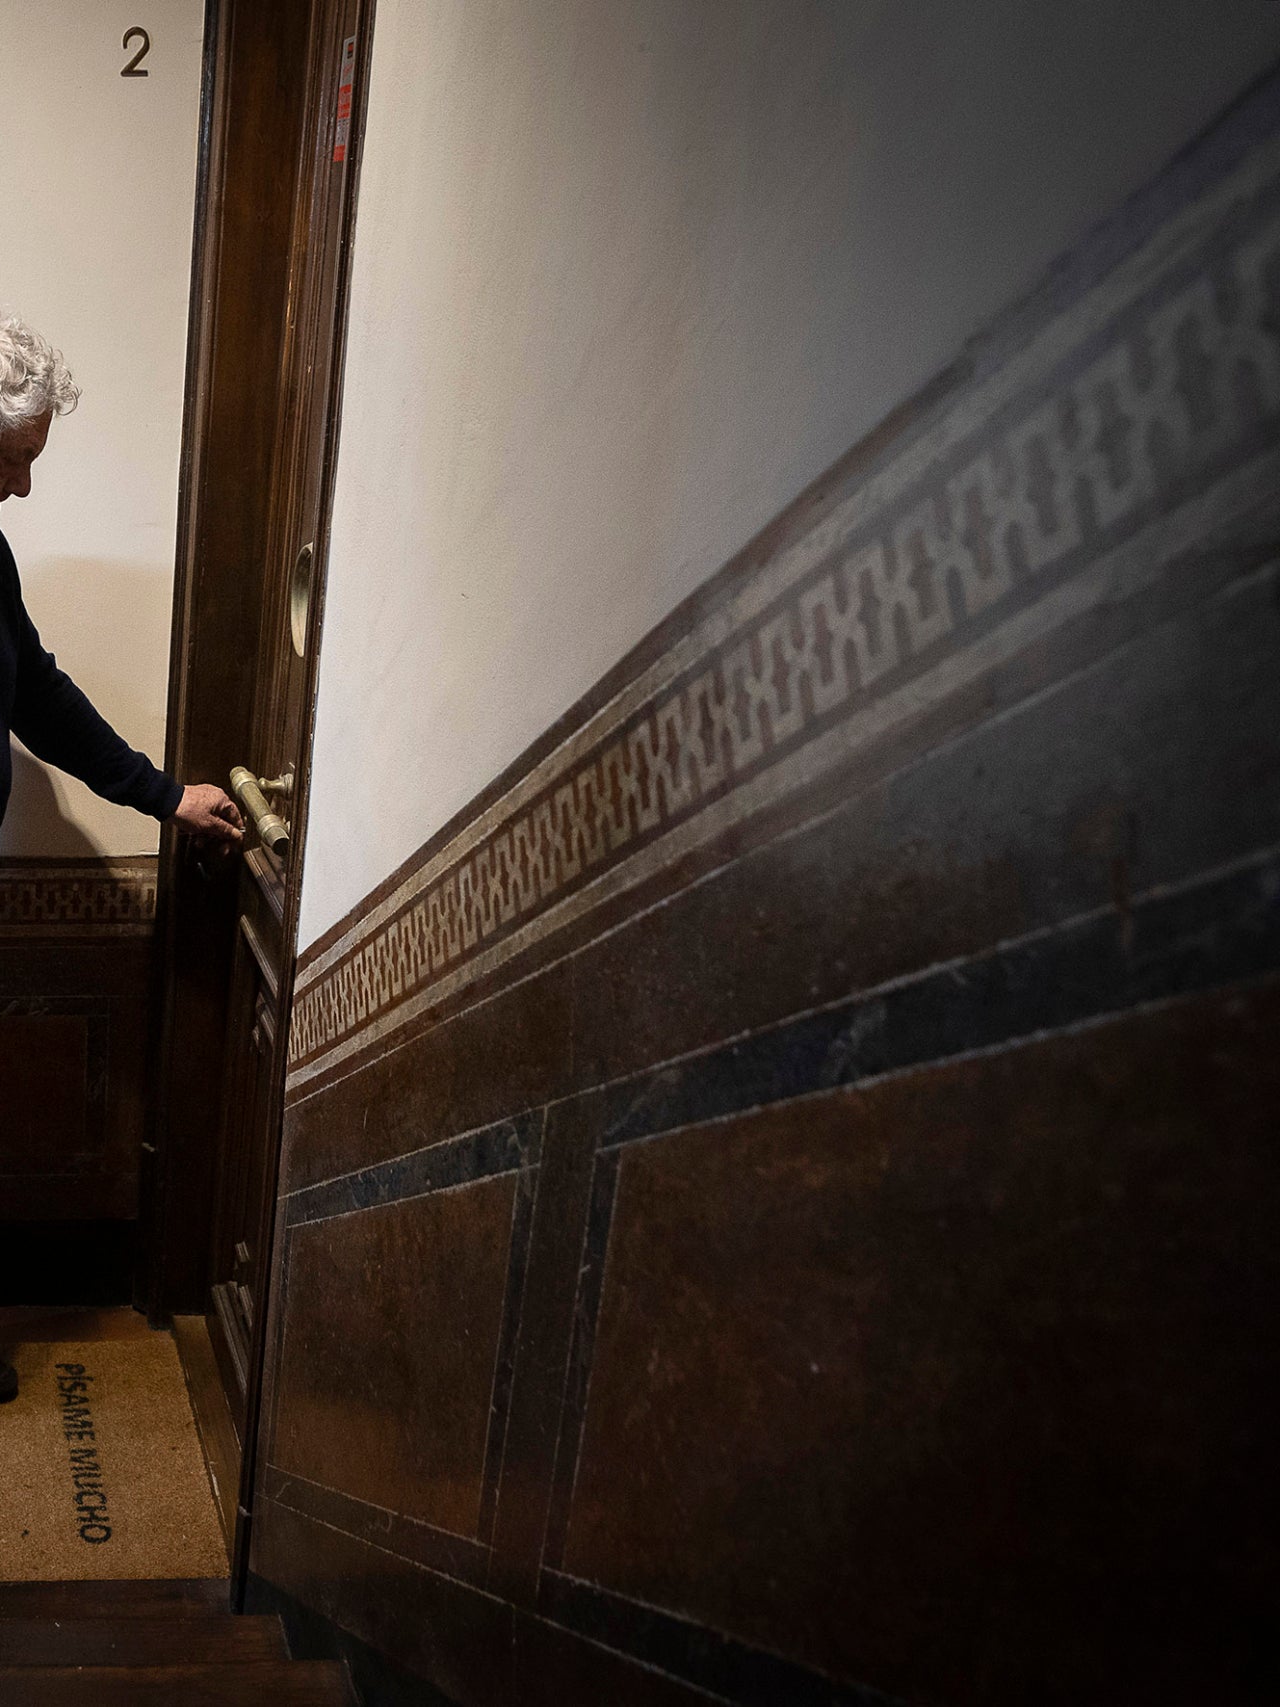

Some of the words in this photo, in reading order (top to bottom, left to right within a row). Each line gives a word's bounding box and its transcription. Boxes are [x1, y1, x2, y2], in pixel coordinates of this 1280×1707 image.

[120, 26, 151, 77] 2
[55, 1363, 95, 1441] PÍSAME
[69, 1447, 112, 1544] MUCHO
